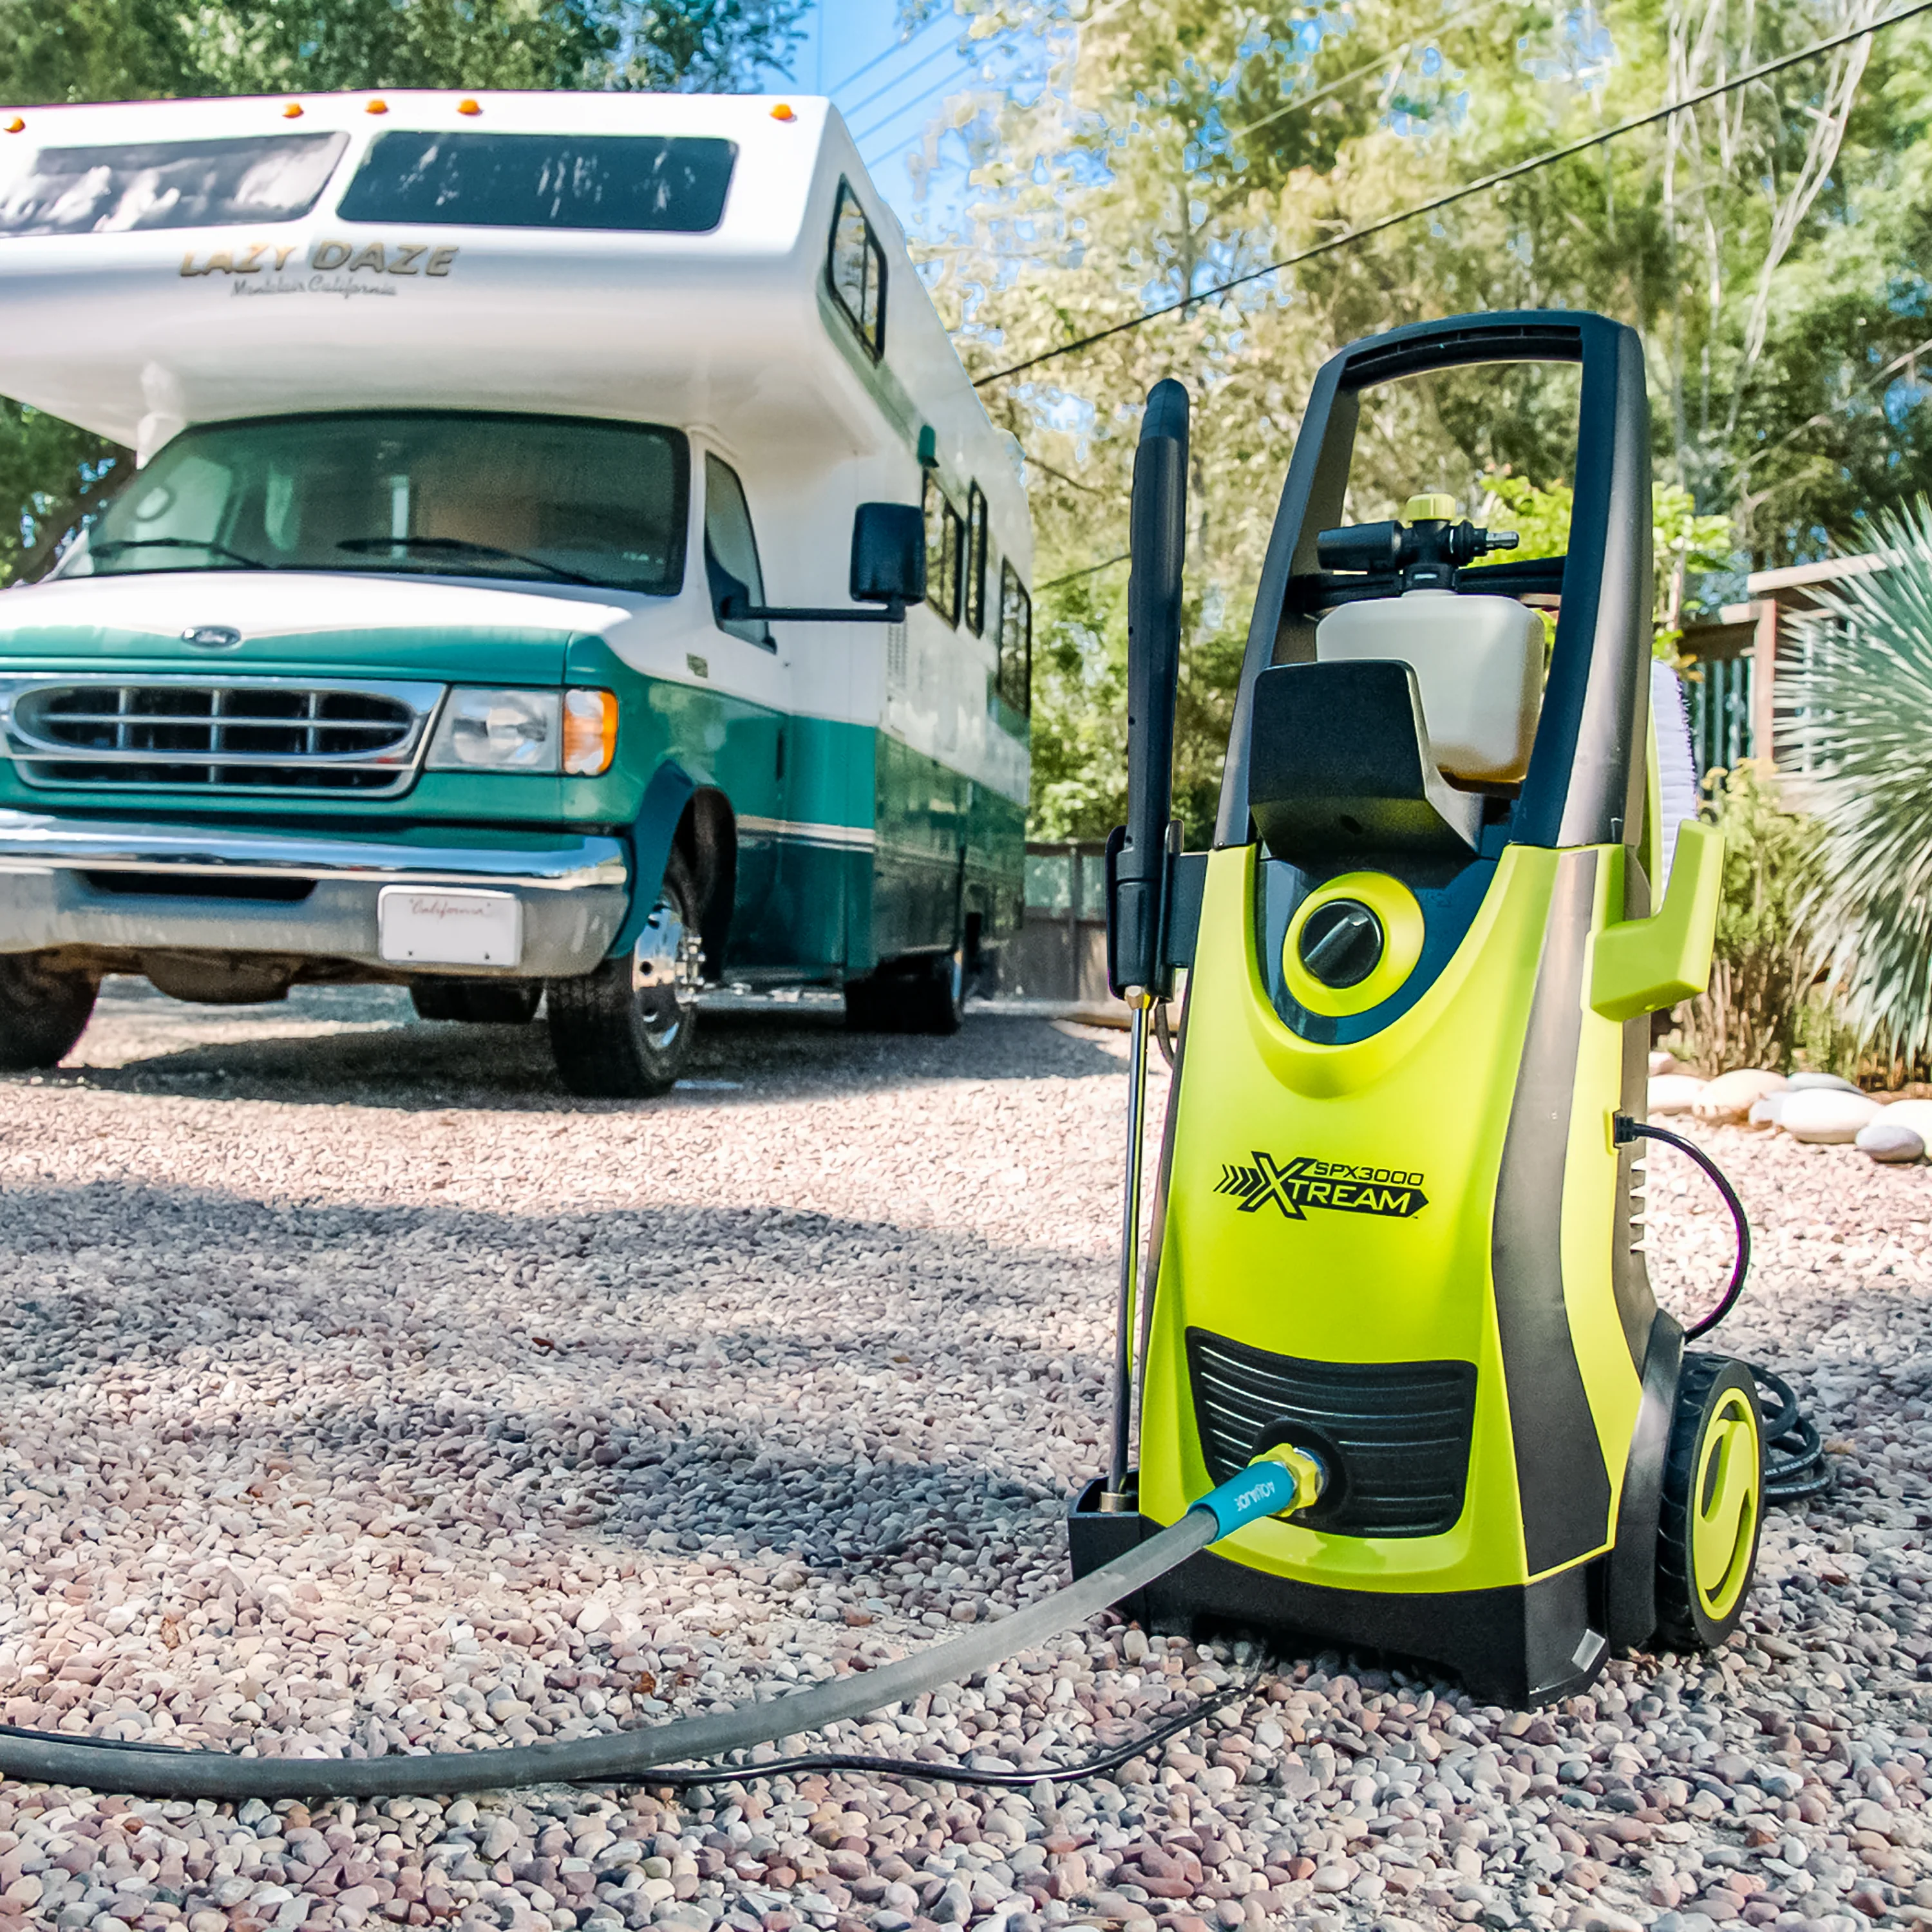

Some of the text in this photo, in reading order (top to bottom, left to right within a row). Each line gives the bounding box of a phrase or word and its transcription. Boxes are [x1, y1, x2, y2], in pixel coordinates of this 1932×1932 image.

[180, 239, 460, 277] LAZY DAZE
[308, 274, 398, 299] California
[412, 898, 484, 919] California
[1237, 1151, 1412, 1221] XTREAM
[1313, 1162, 1424, 1186] SPX3000
